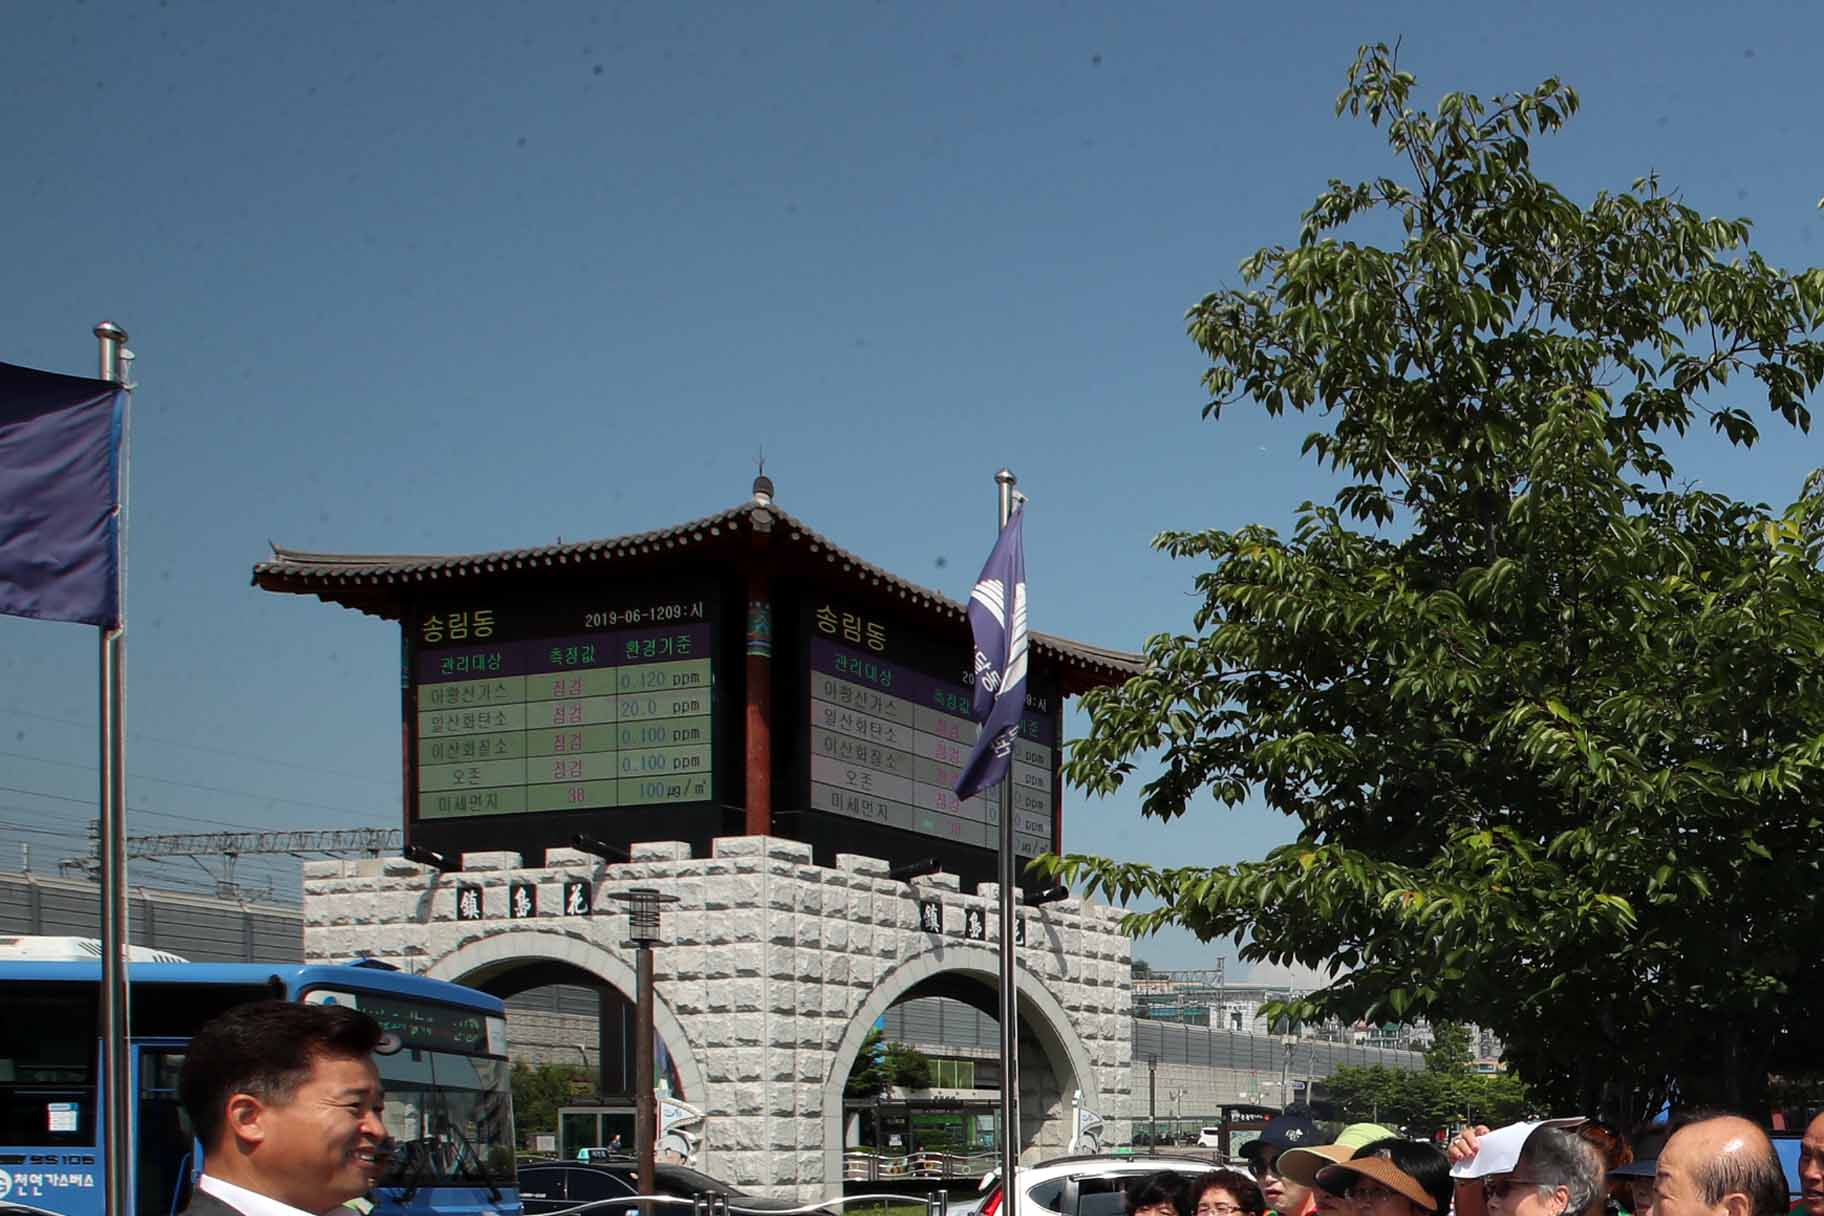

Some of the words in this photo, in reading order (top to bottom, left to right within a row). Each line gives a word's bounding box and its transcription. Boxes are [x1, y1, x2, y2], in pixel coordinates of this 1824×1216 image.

[423, 608, 496, 644] 송림동
[815, 604, 887, 651] 송림동
[440, 652, 503, 675] 관리대상
[549, 643, 596, 666] 측정값
[624, 634, 692, 659] 환경기준
[672, 671, 701, 686] ppm
[834, 654, 894, 687] 관리대상
[672, 700, 701, 714] ppm
[672, 726, 701, 742] ppm
[452, 766, 482, 785] 오존
[672, 754, 701, 770] ppm
[845, 769, 873, 788] 오존
[14, 1172, 96, 1197] 천연가스버스
